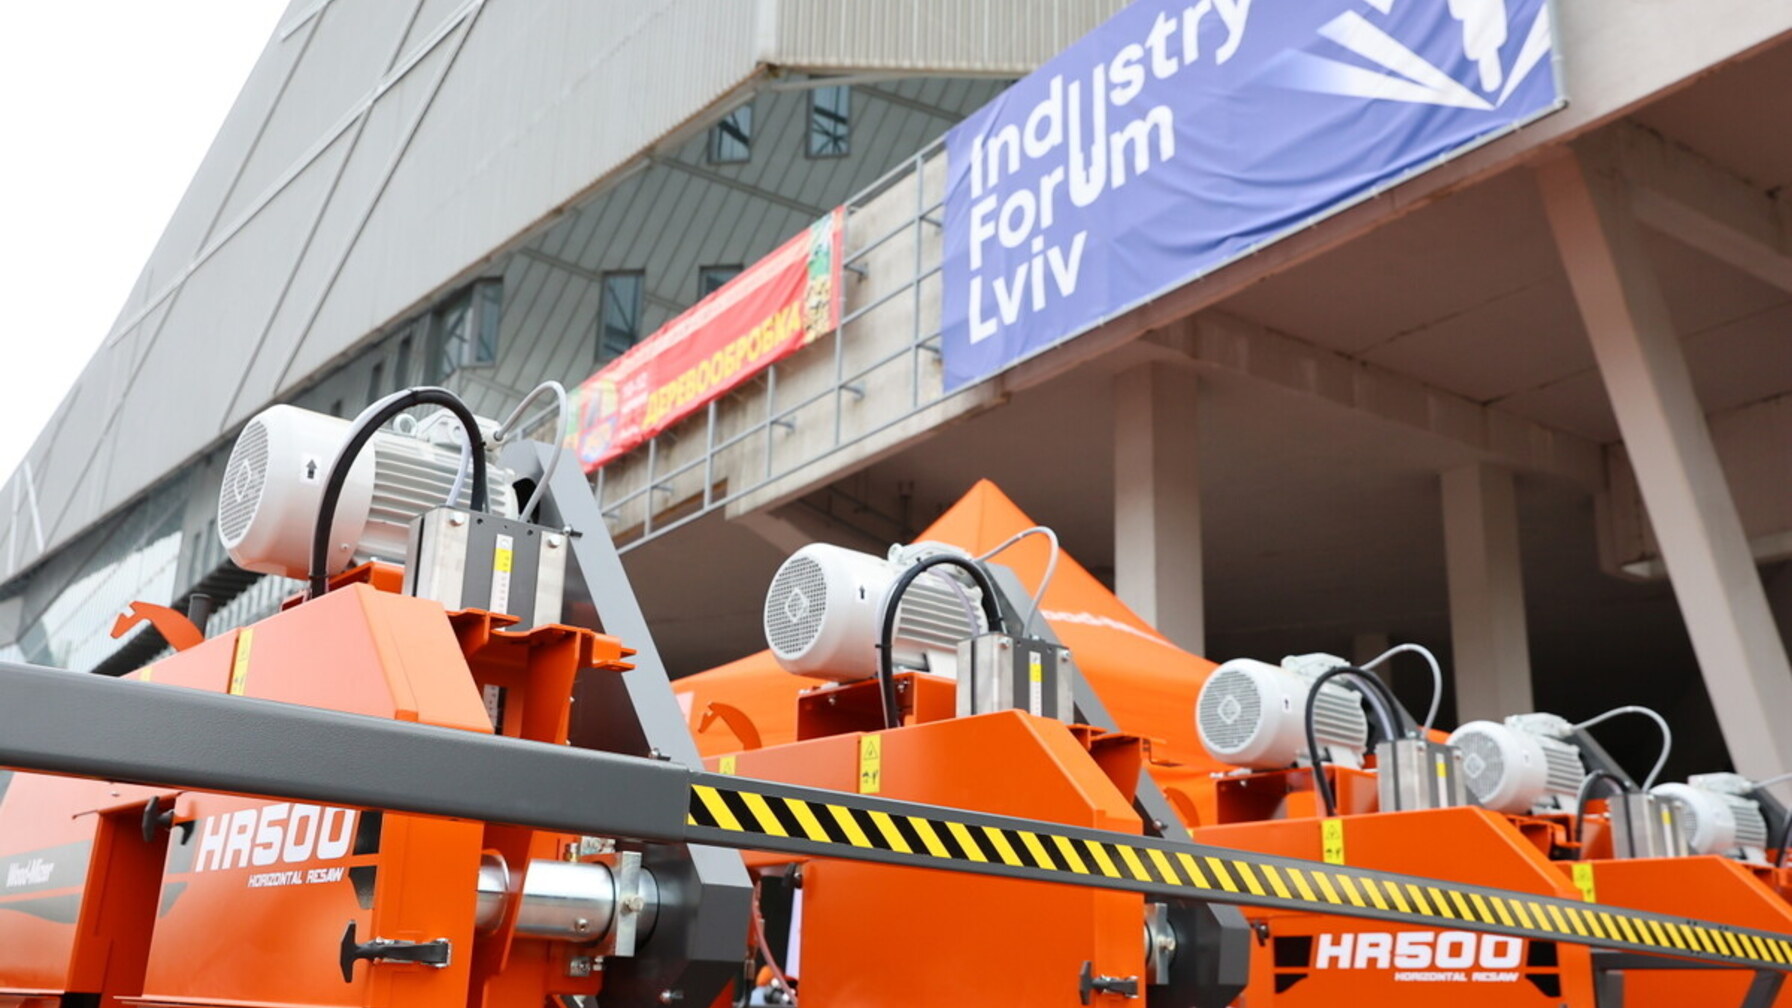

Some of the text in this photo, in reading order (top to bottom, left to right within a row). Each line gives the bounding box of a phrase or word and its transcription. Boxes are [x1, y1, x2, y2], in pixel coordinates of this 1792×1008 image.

[968, 230, 1087, 345] Lviv
[195, 802, 356, 872] HR500
[248, 866, 345, 888] HORIZONTAL RESAW
[1315, 931, 1524, 969] HR500
[1394, 971, 1520, 982] HORIZONTAL RESAW
